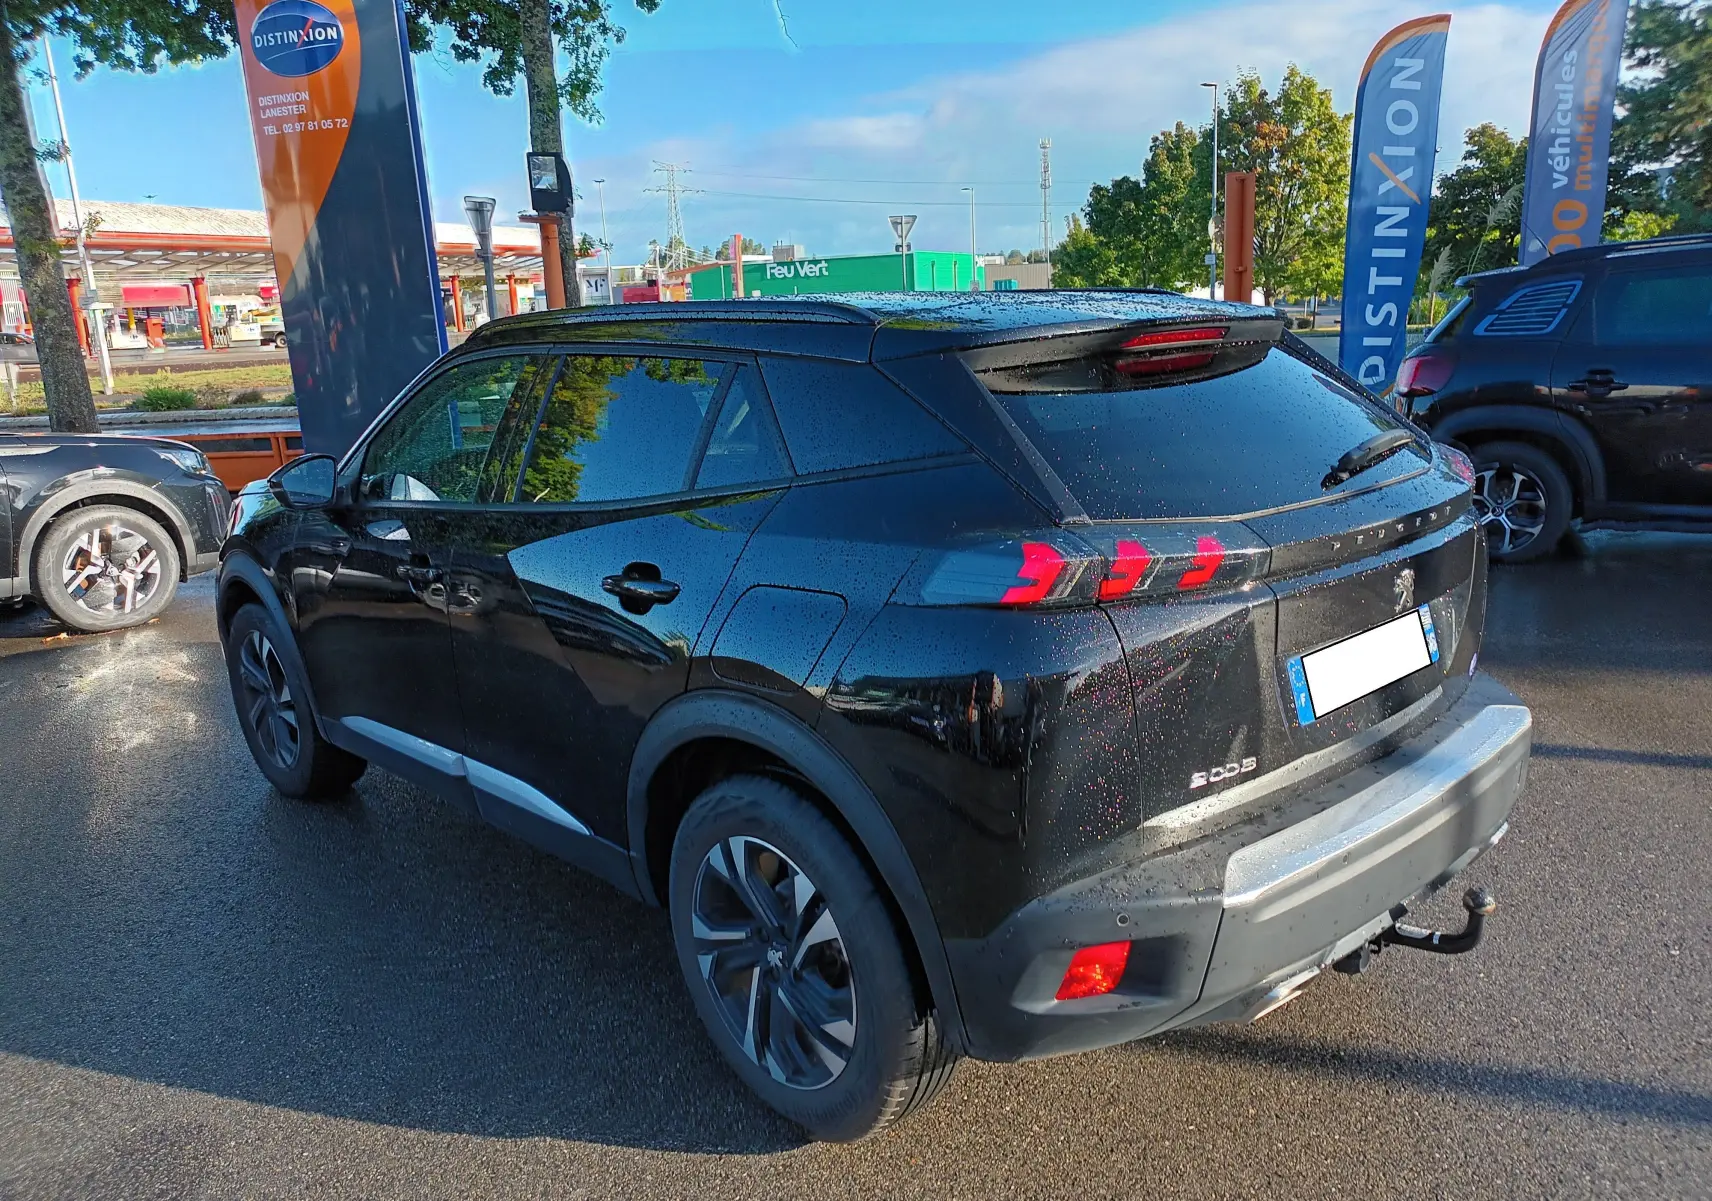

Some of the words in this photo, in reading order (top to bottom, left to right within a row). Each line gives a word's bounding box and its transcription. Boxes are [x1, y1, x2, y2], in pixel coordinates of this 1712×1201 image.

[254, 18, 338, 48] DISTINXION
[258, 91, 309, 107] DISTINXION
[260, 104, 307, 118] LANESTER
[1548, 49, 1578, 190] véhicules
[282, 123, 293, 133] 02
[295, 121, 305, 132] 97
[308, 120, 319, 130] 81
[321, 119, 333, 129] 05
[335, 118, 348, 128] 72
[1357, 57, 1425, 386] DISTINXION
[766, 263, 795, 280] Feu
[795, 260, 829, 278] Vert
